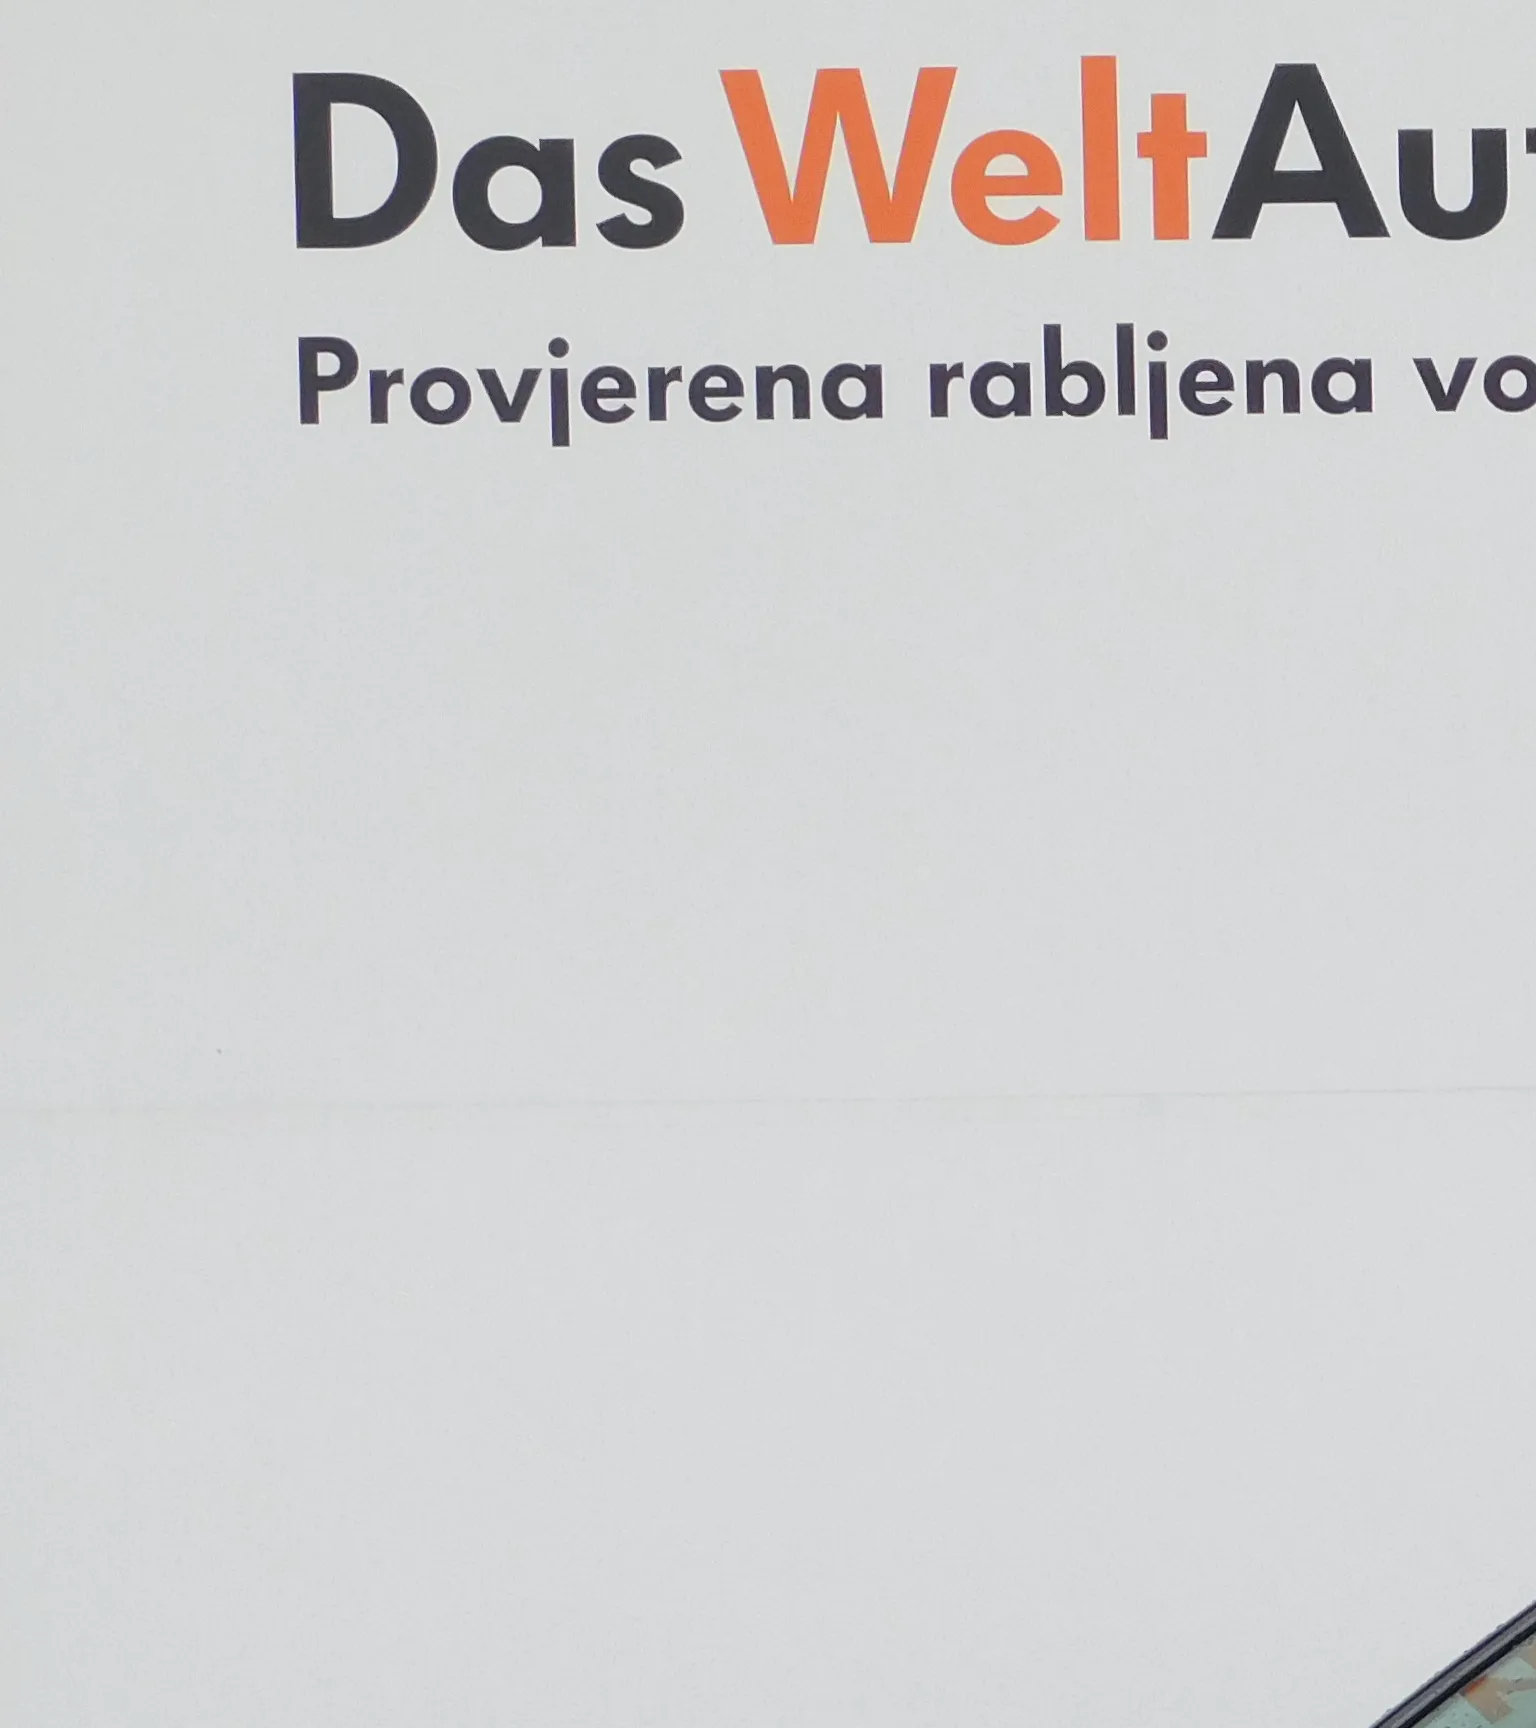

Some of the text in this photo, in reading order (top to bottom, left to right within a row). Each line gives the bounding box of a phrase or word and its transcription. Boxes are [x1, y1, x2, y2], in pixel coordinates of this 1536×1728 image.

[293, 72, 685, 251] Das
[298, 335, 883, 448] Provjerena
[929, 322, 1373, 441] rabljena
